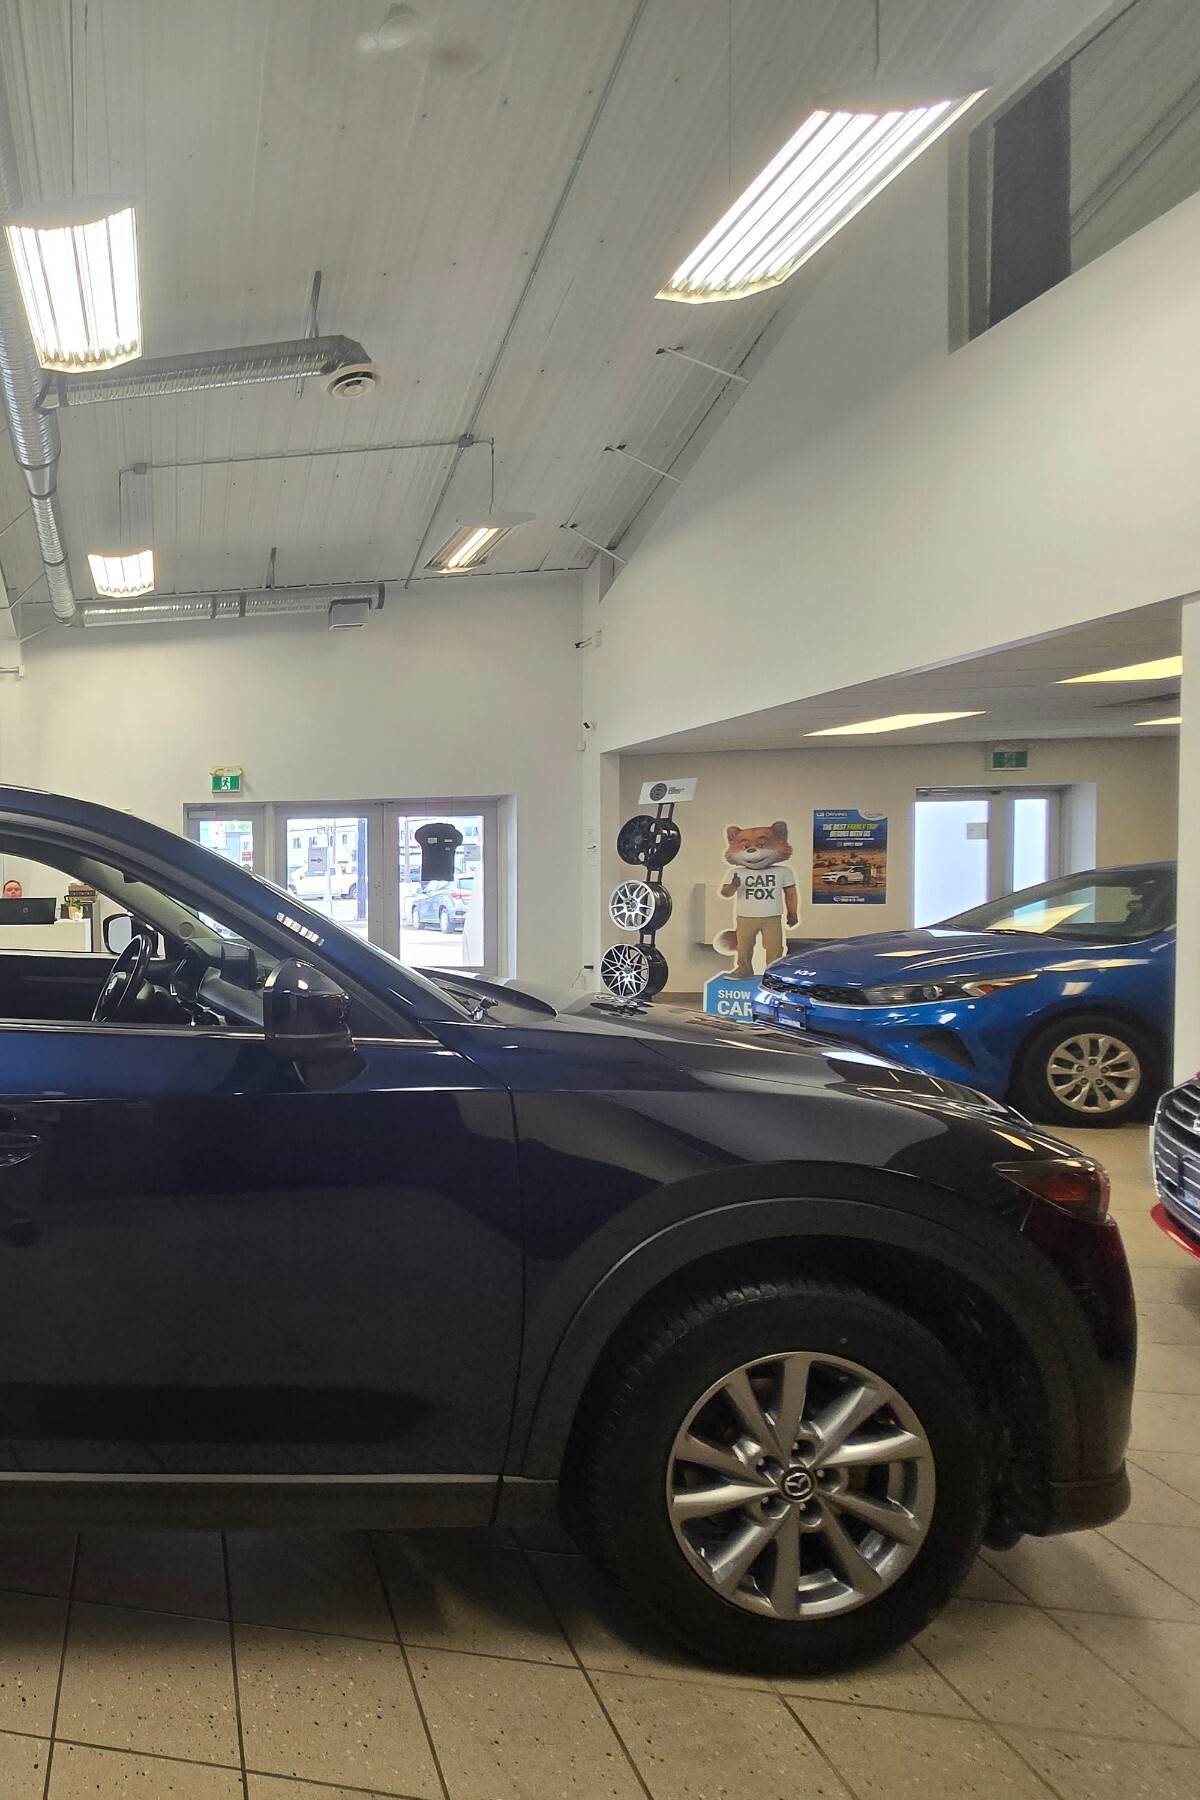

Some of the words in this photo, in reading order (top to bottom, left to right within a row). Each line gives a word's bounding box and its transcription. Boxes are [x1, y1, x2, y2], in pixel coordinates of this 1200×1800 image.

[745, 875, 775, 887] CAR
[745, 888, 775, 900] FOX
[718, 990, 750, 999] SHOW
